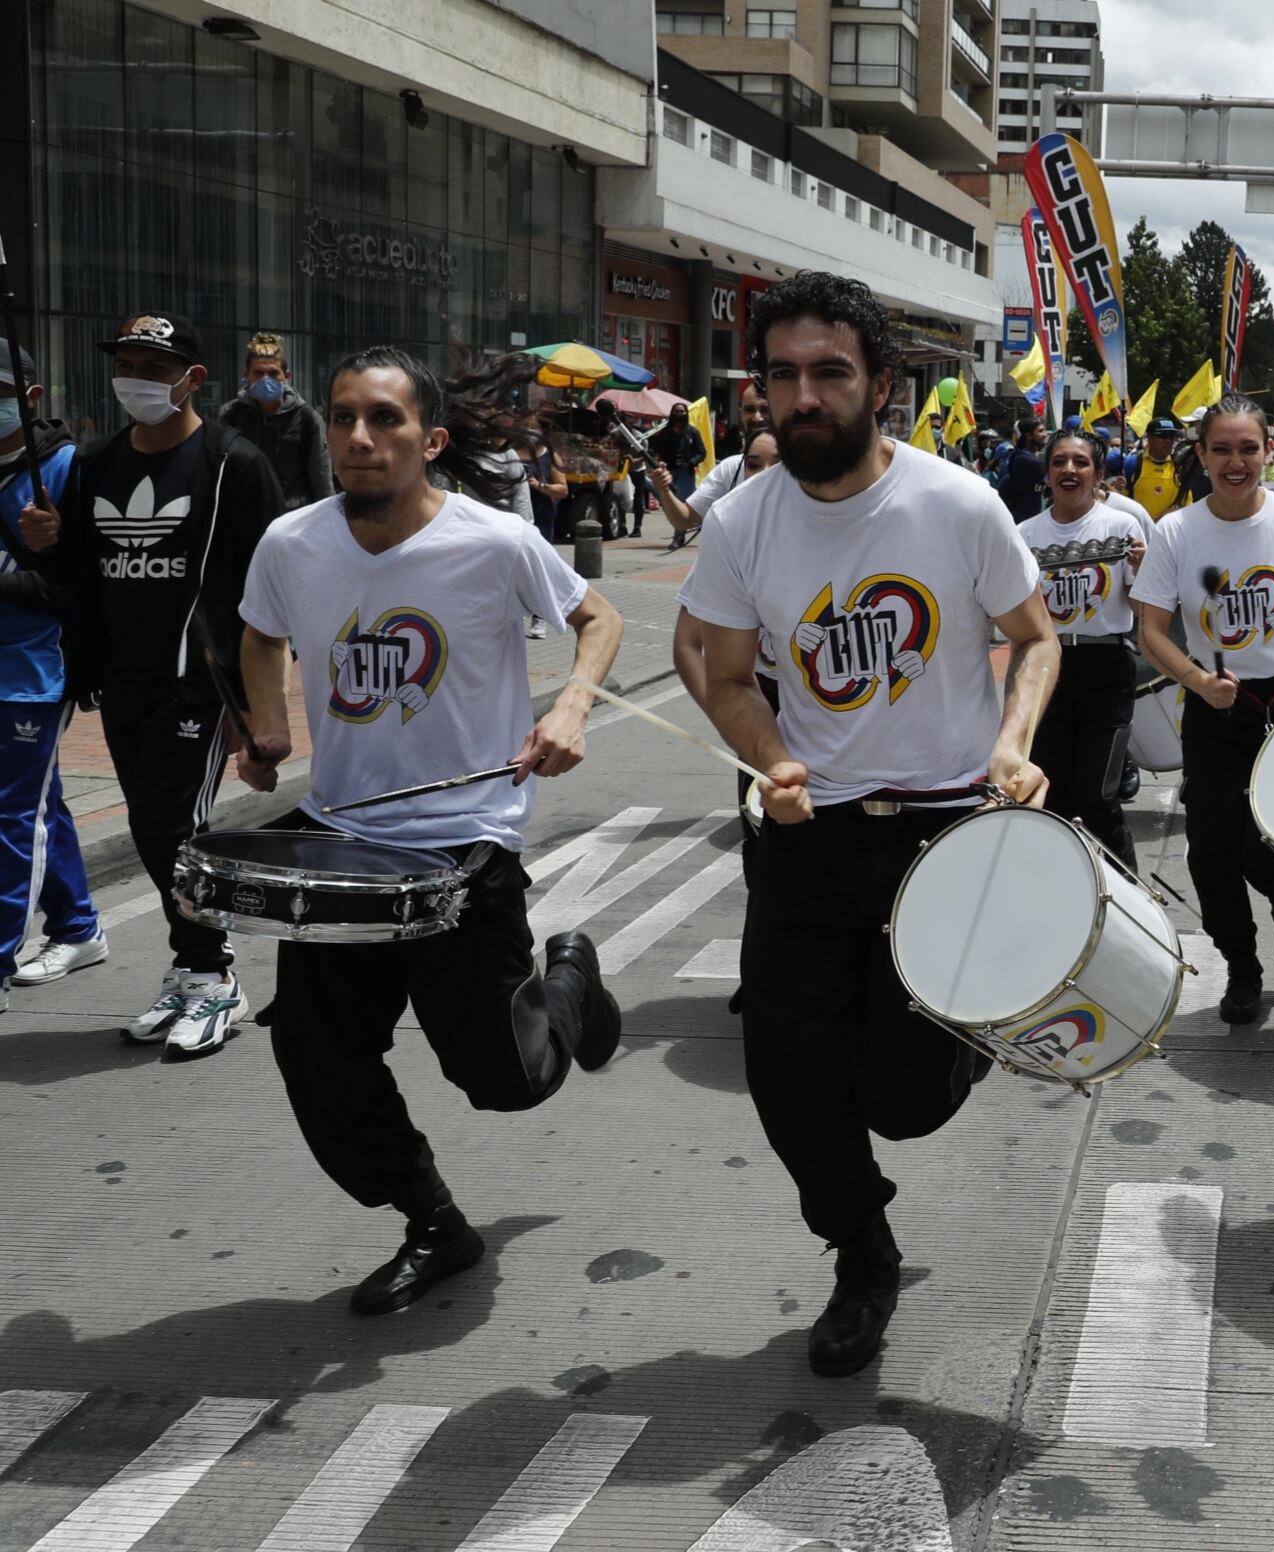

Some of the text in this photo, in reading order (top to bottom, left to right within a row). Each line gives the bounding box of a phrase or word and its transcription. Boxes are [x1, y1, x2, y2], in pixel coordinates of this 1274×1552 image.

[1043, 145, 1113, 307] CUT
[612, 271, 671, 301] Kentucky Fried Chicken
[1032, 220, 1061, 355] CUT
[100, 552, 187, 578] adidas
[1053, 574, 1090, 610] CUT
[1222, 588, 1269, 629] CUT
[347, 633, 410, 699] CUT
[823, 610, 898, 679] CUT
